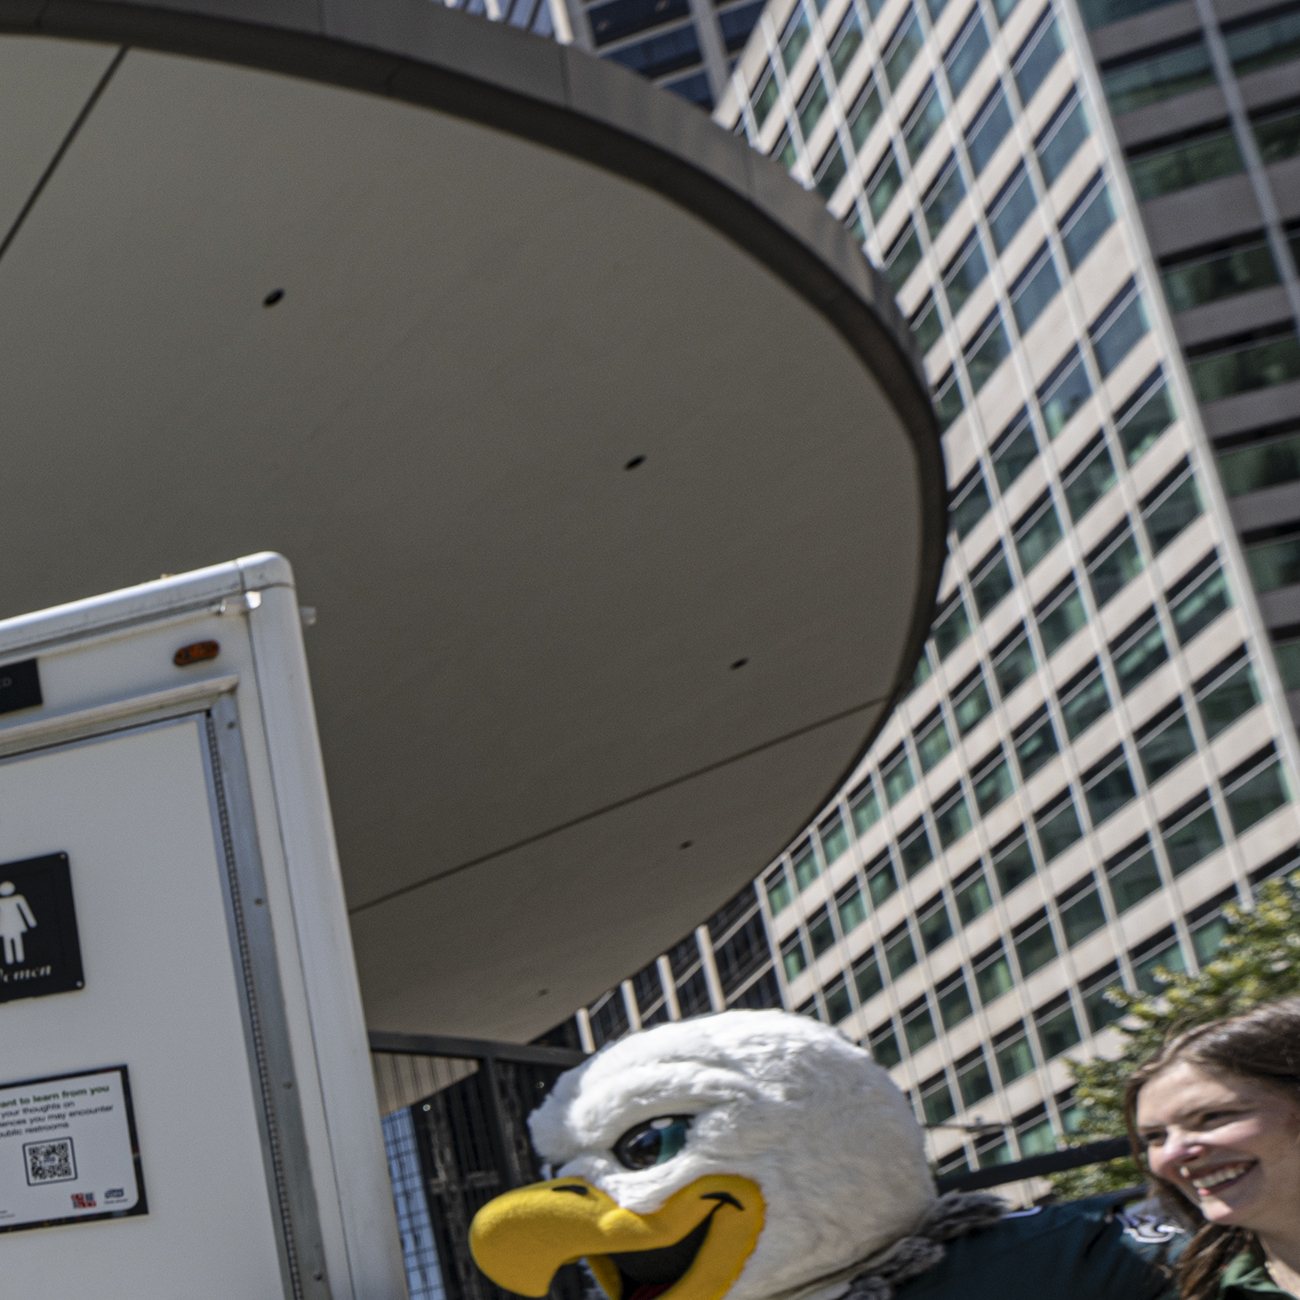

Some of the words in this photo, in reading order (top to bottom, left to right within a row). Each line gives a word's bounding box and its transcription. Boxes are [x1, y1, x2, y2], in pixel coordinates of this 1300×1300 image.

[19, 1097, 31, 1105] to
[32, 1092, 60, 1103] learn
[62, 1088, 87, 1099] from
[89, 1085, 110, 1096] you
[22, 1103, 61, 1115] thoughts
